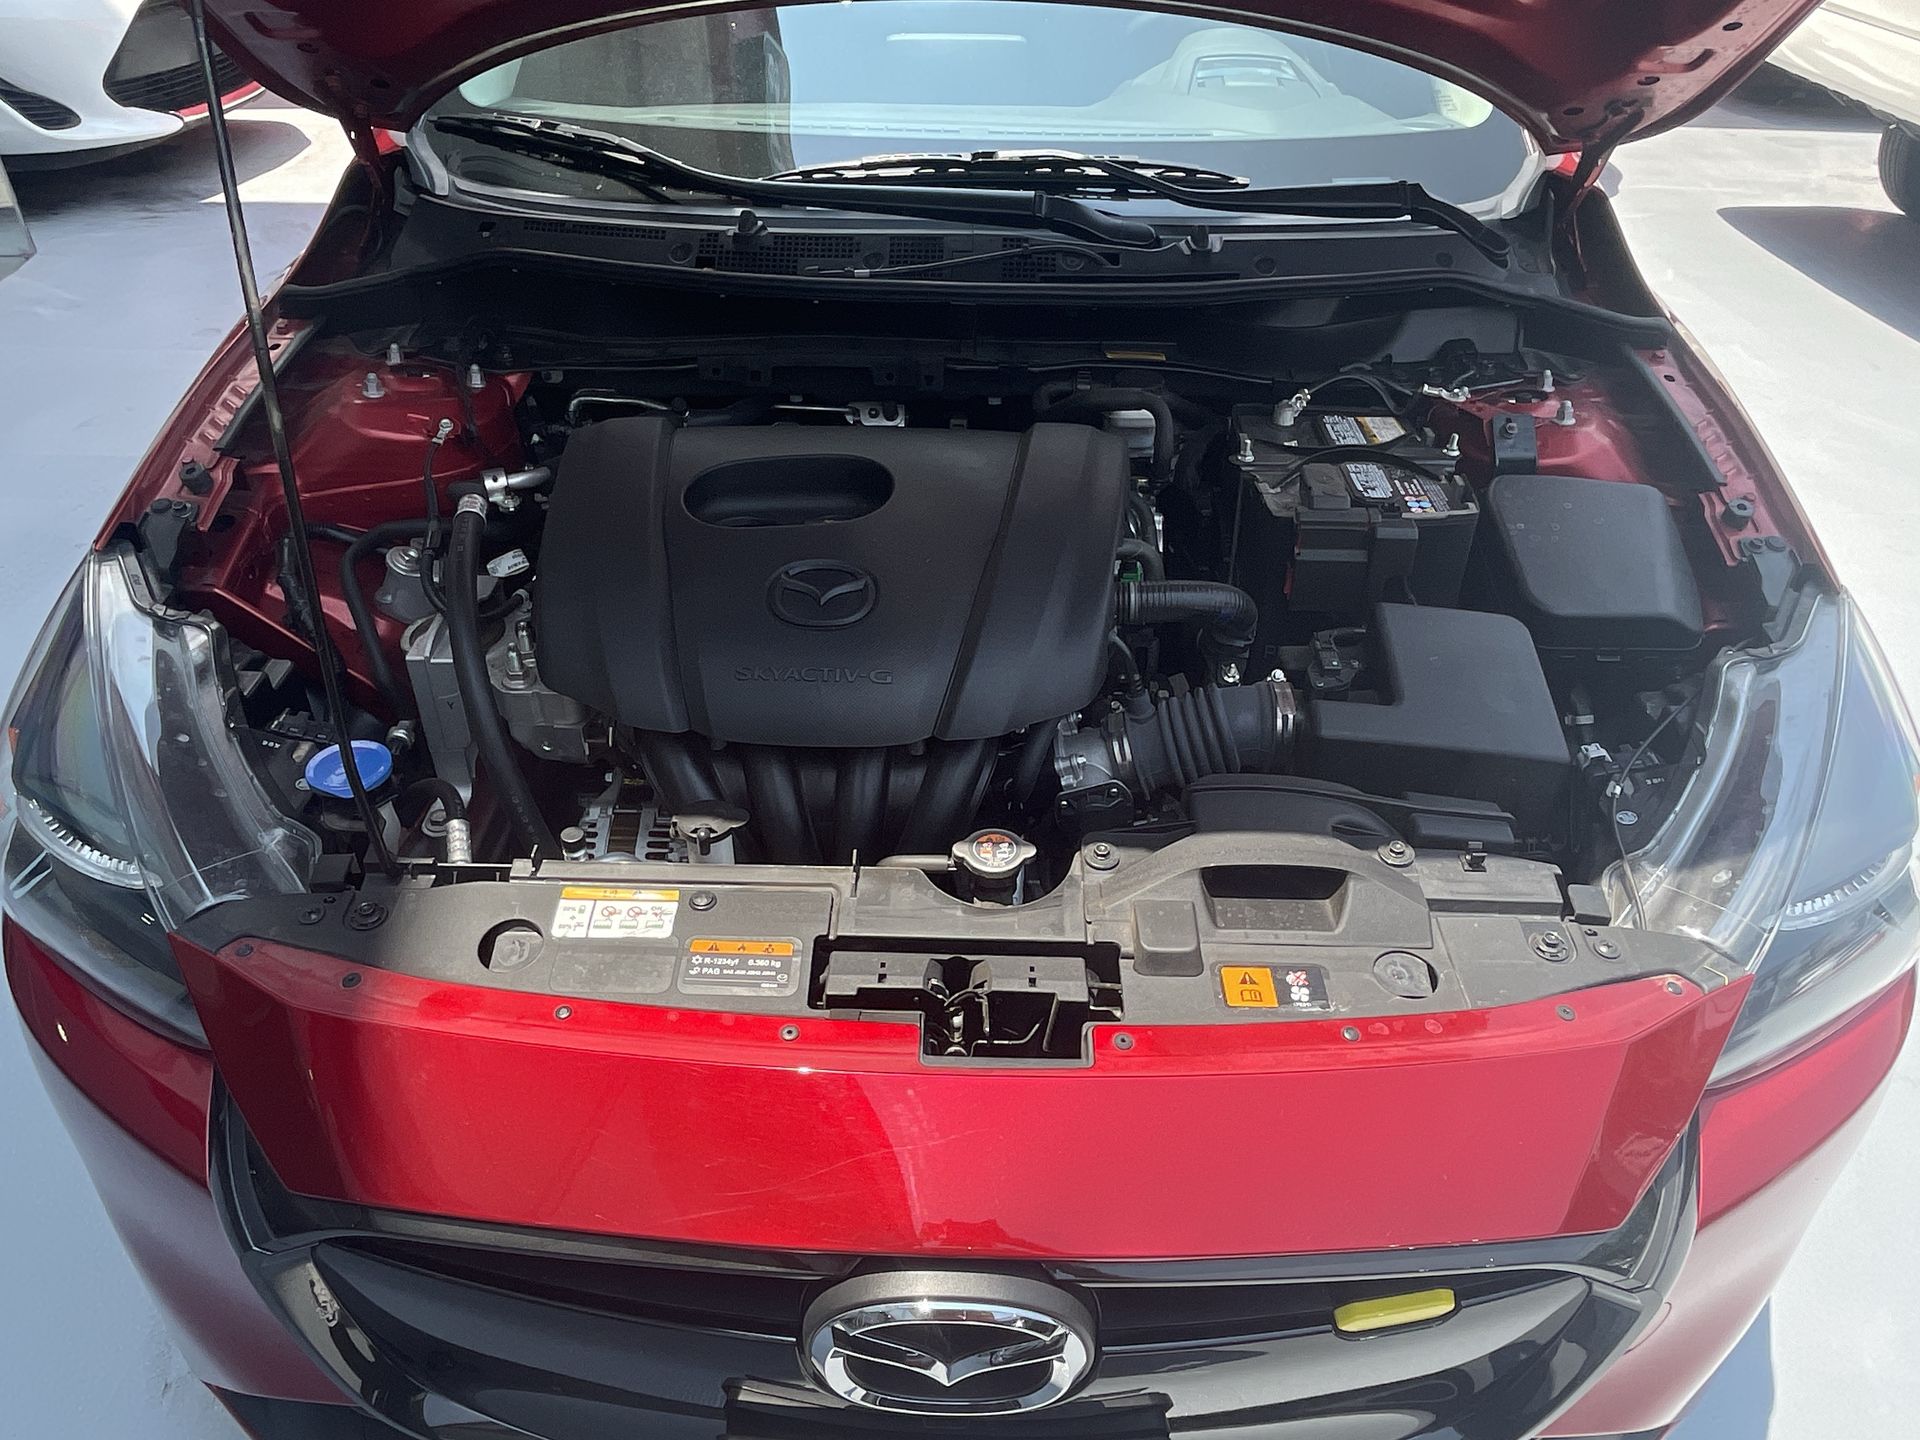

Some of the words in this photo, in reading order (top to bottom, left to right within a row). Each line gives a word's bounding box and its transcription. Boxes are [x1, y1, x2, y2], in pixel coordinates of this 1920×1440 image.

[735, 666, 894, 685] SKYACTIV-G
[704, 957, 740, 967] R-1234yf
[770, 960, 782, 968] kg
[702, 967, 721, 975] PAG
